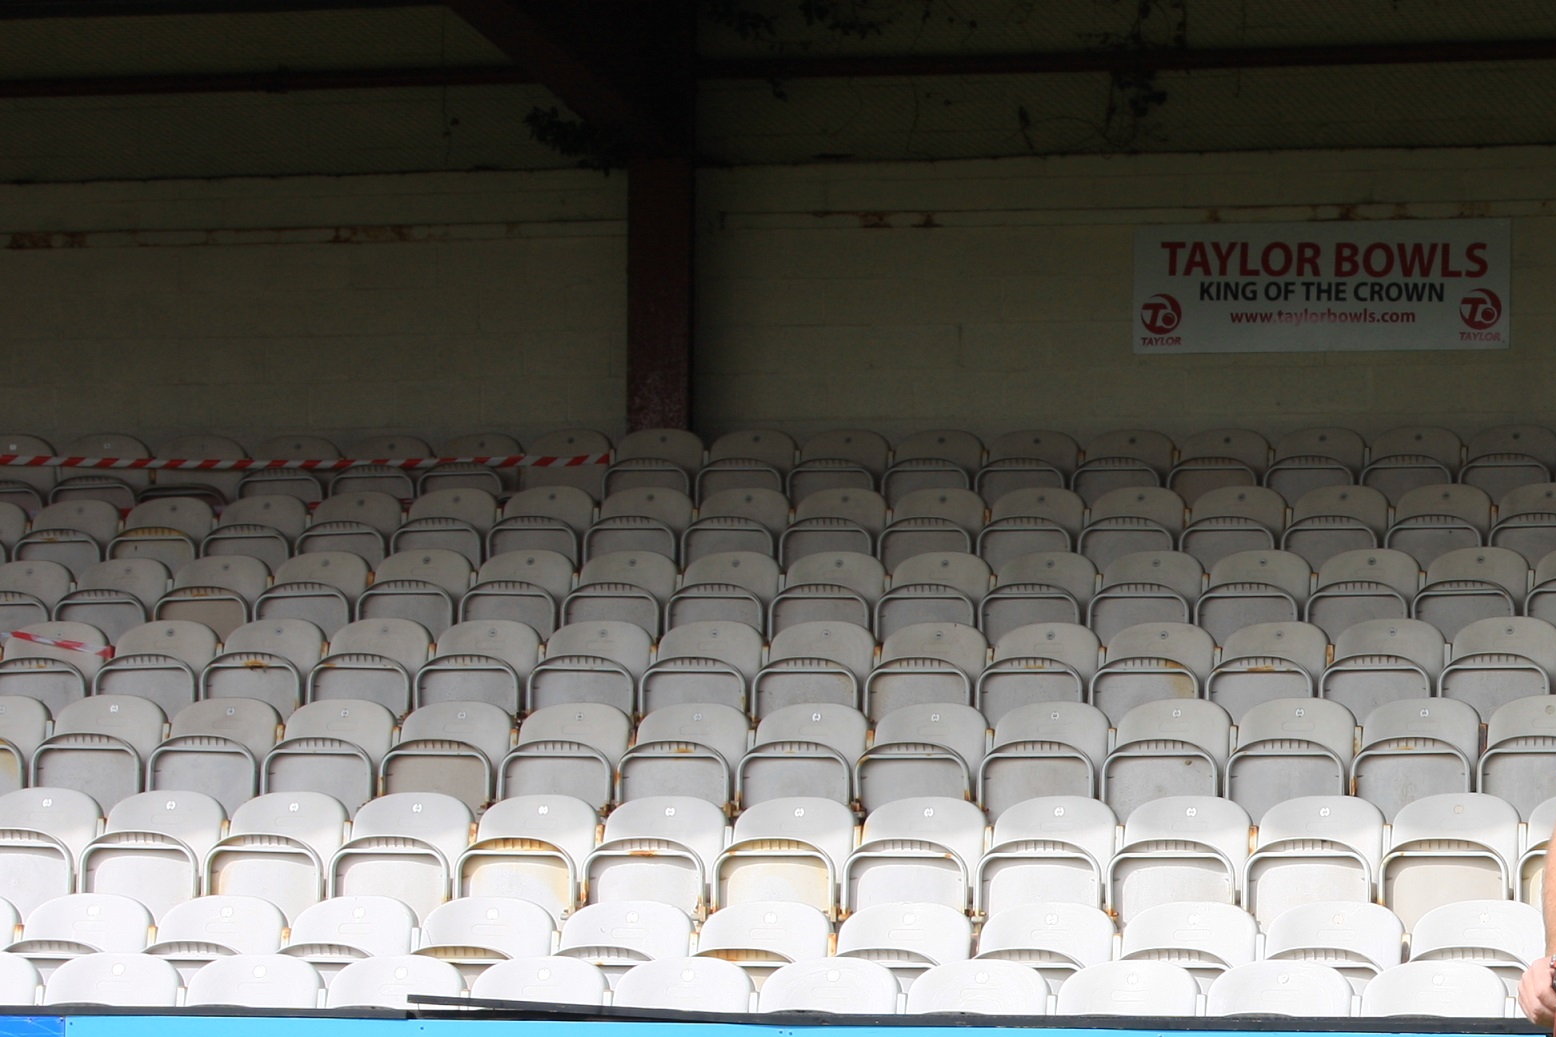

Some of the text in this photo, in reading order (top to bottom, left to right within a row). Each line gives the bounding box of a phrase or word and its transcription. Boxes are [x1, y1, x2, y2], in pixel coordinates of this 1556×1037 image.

[1161, 241, 1489, 278] TAYLOR BOWLS
[1200, 281, 1445, 302] KING OF THE CROWN
[1230, 309, 1416, 327] www.taylorbowls.com
[1140, 336, 1182, 347] TAYLOR
[1459, 331, 1501, 342] TAYLOR
